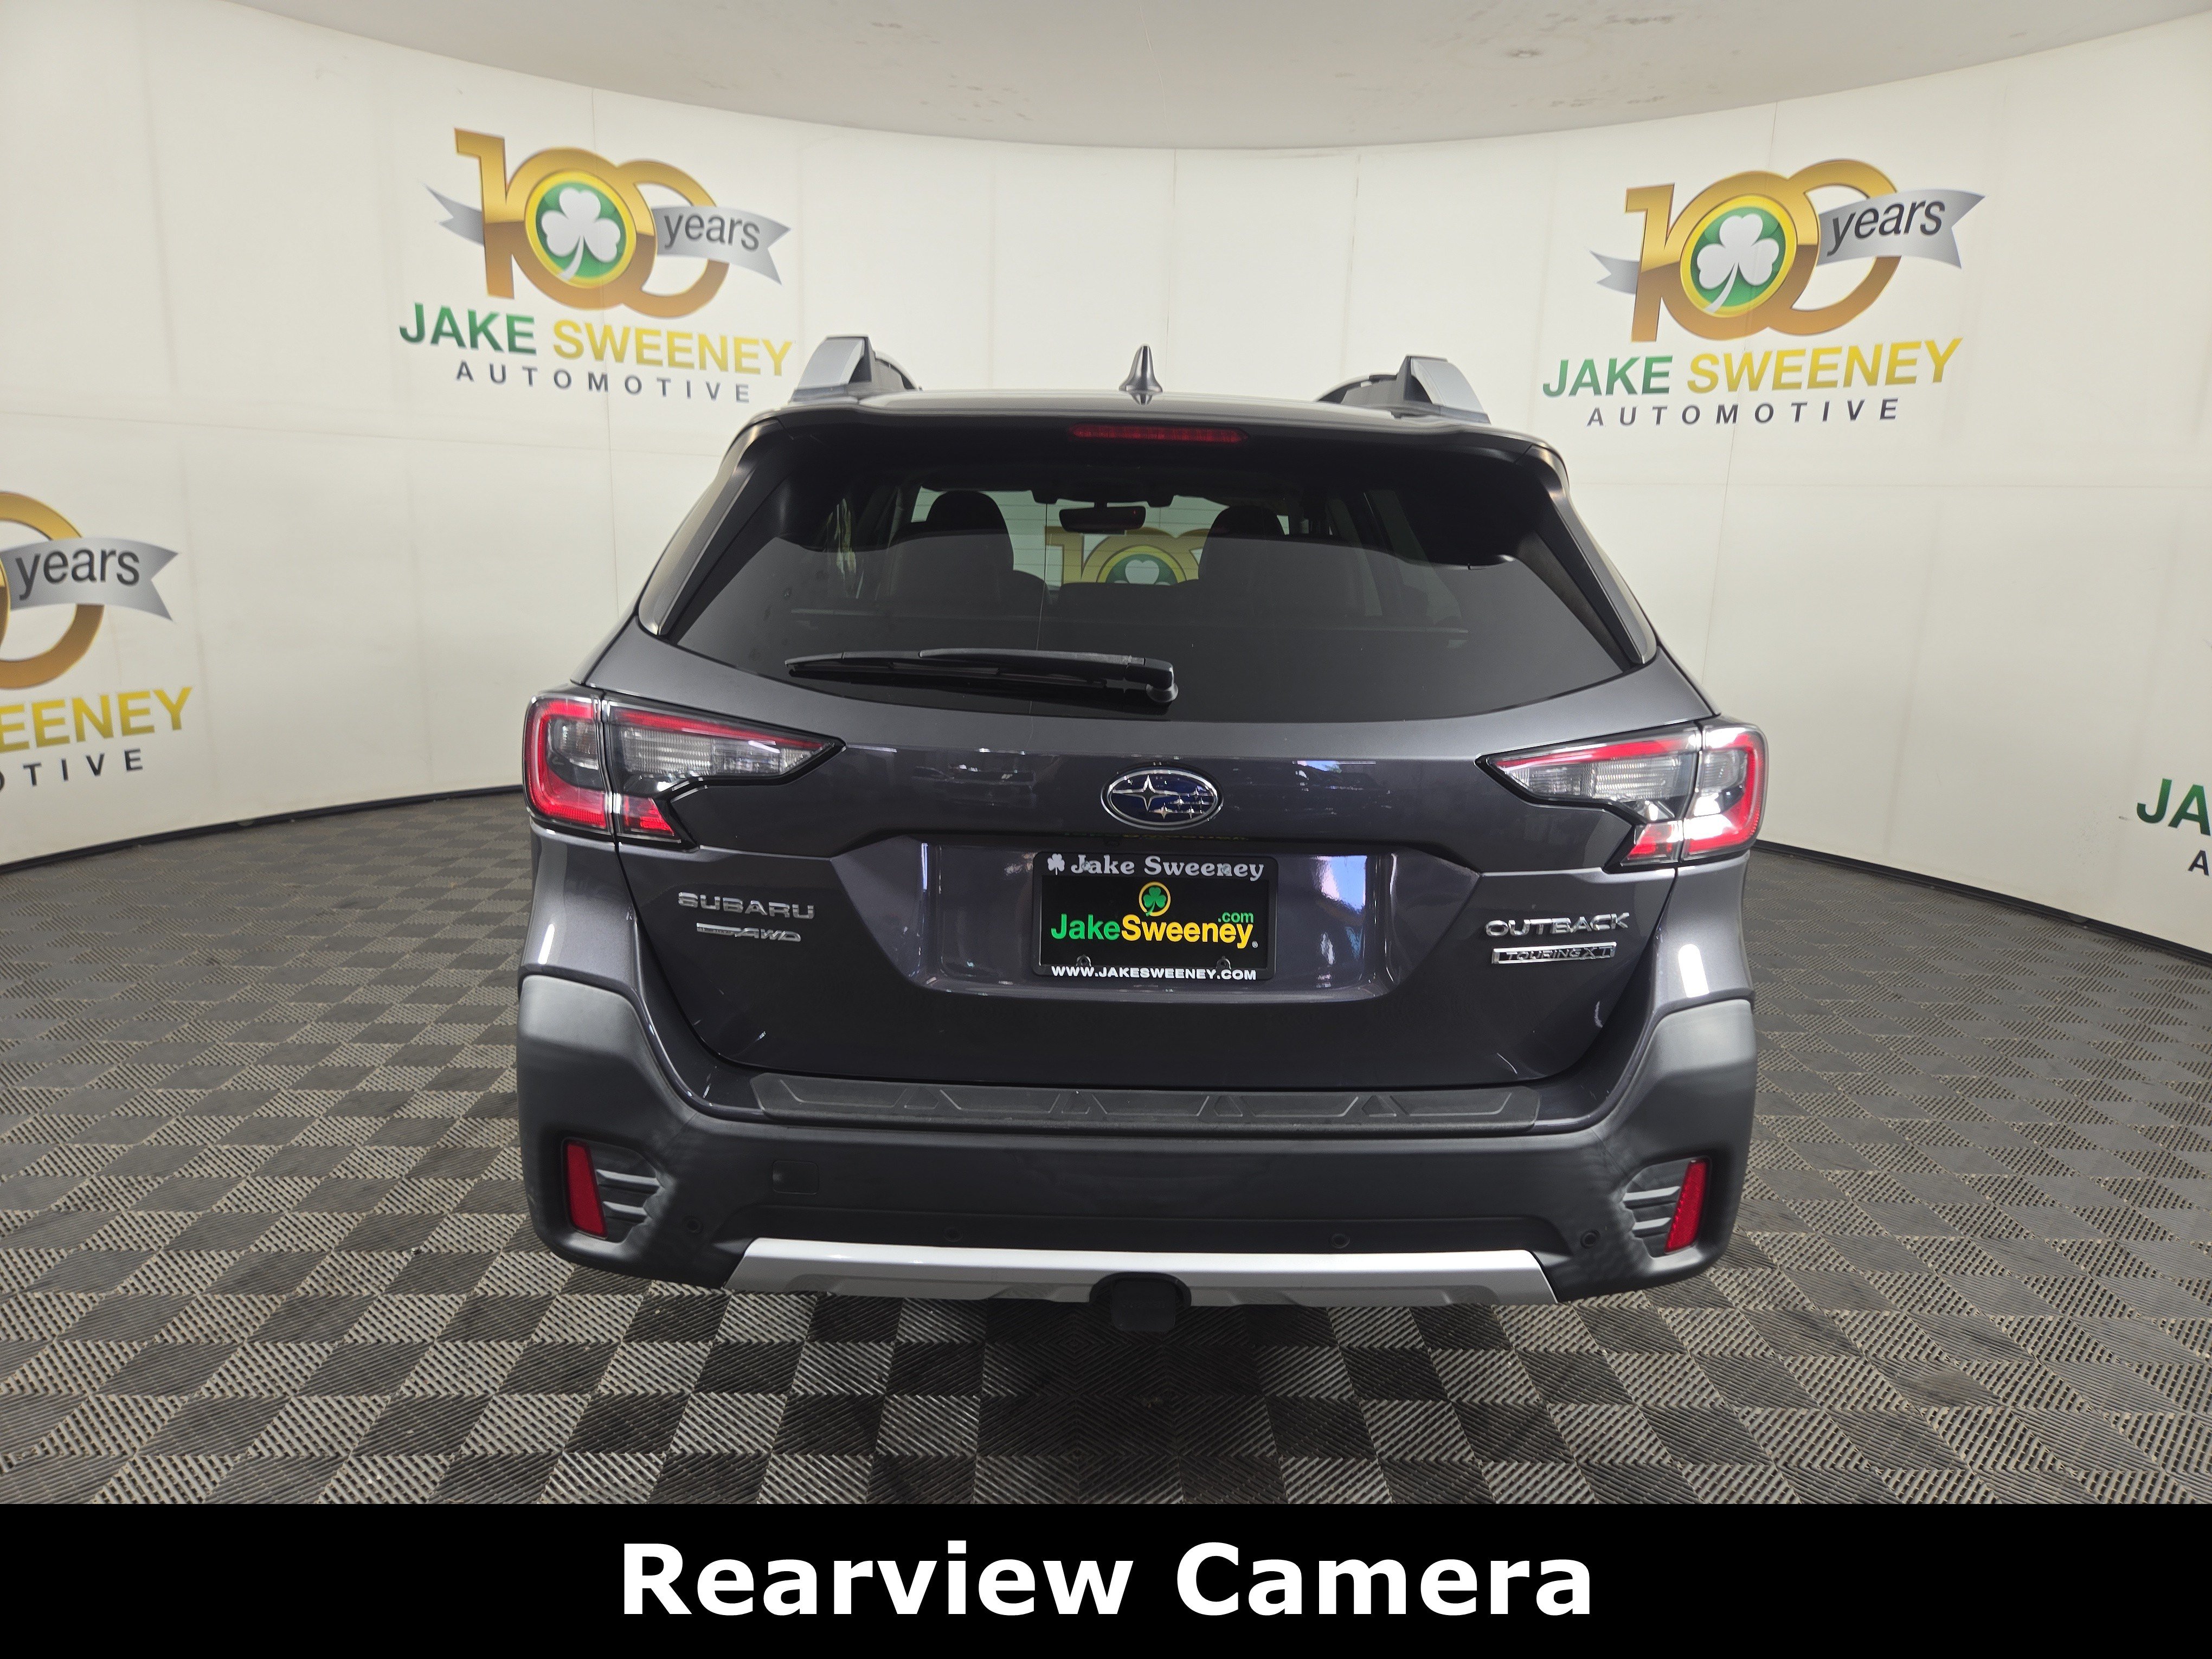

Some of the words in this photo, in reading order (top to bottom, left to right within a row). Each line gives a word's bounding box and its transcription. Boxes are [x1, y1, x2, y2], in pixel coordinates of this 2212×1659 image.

[454, 128, 730, 319] 100
[664, 212, 760, 251] years
[1826, 198, 1945, 256] years
[1625, 158, 1902, 343] 100
[399, 302, 537, 356] JAKE
[553, 319, 793, 376] SWEENEY
[456, 360, 750, 402] AUTOMOTIVE
[1542, 355, 1673, 397] JAKE
[1687, 337, 1964, 395] SWEENEY
[1586, 397, 1899, 427] AUTOMOTIVE
[15, 548, 140, 600] years
[0, 686, 192, 755] EENEY
[2136, 777, 2212, 837] JA
[1071, 854, 1135, 874] Jake
[1144, 855, 1264, 882] Sweeney
[678, 892, 815, 919] SUBARU
[1484, 912, 1630, 937] OUTBACK
[735, 927, 801, 942] AWD
[1051, 966, 1256, 980] WWW.JAKESWEENEY.COM
